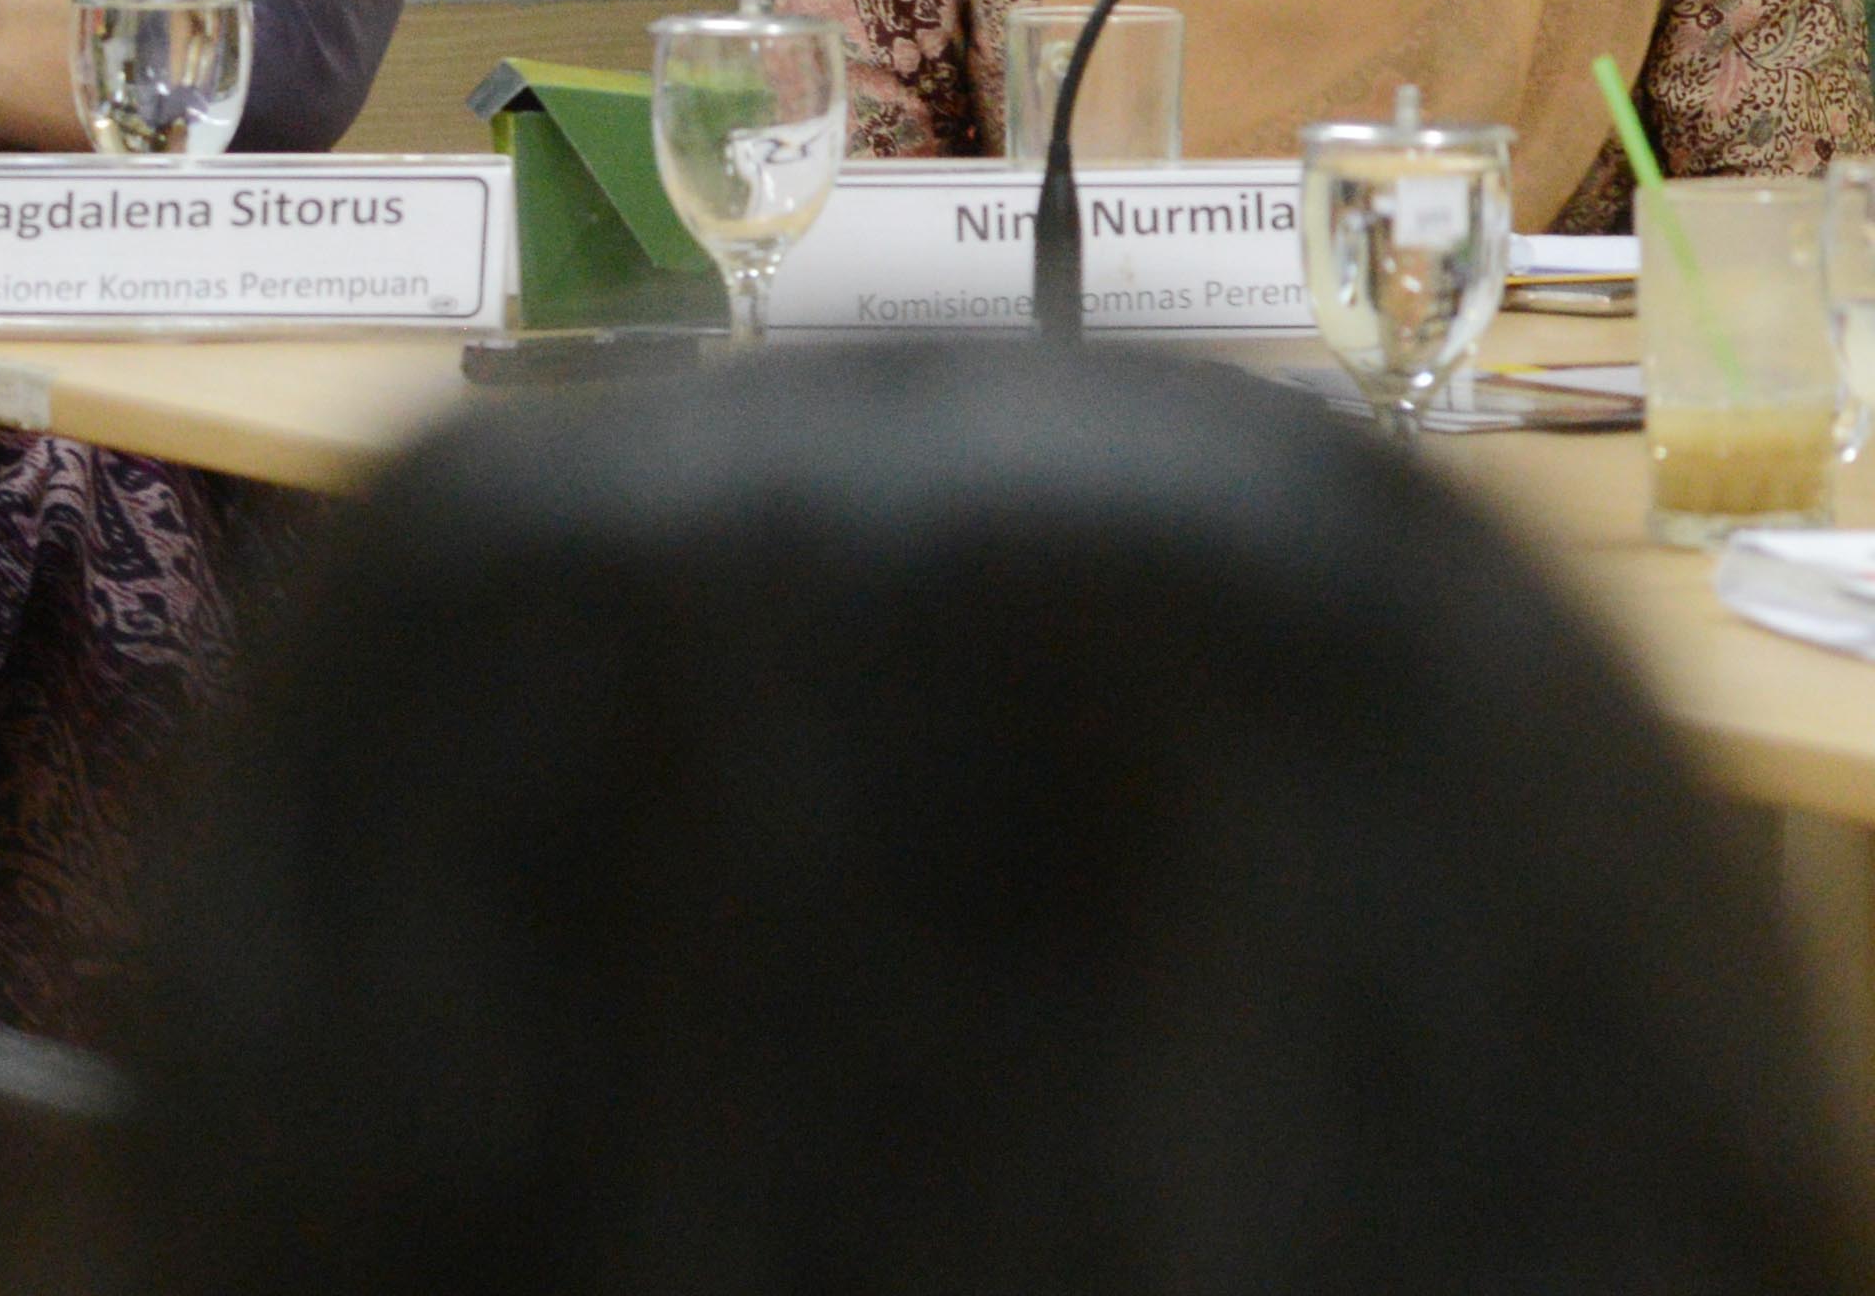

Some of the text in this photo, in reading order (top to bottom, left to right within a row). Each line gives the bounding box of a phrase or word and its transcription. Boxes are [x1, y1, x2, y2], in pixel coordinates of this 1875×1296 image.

[230, 189, 405, 228] Sitorus
[955, 193, 1298, 243] Nin Nurmila
[97, 272, 228, 304] Komnas
[238, 269, 430, 306] Perempuan
[856, 279, 1309, 323] Komisione omnas Perem
